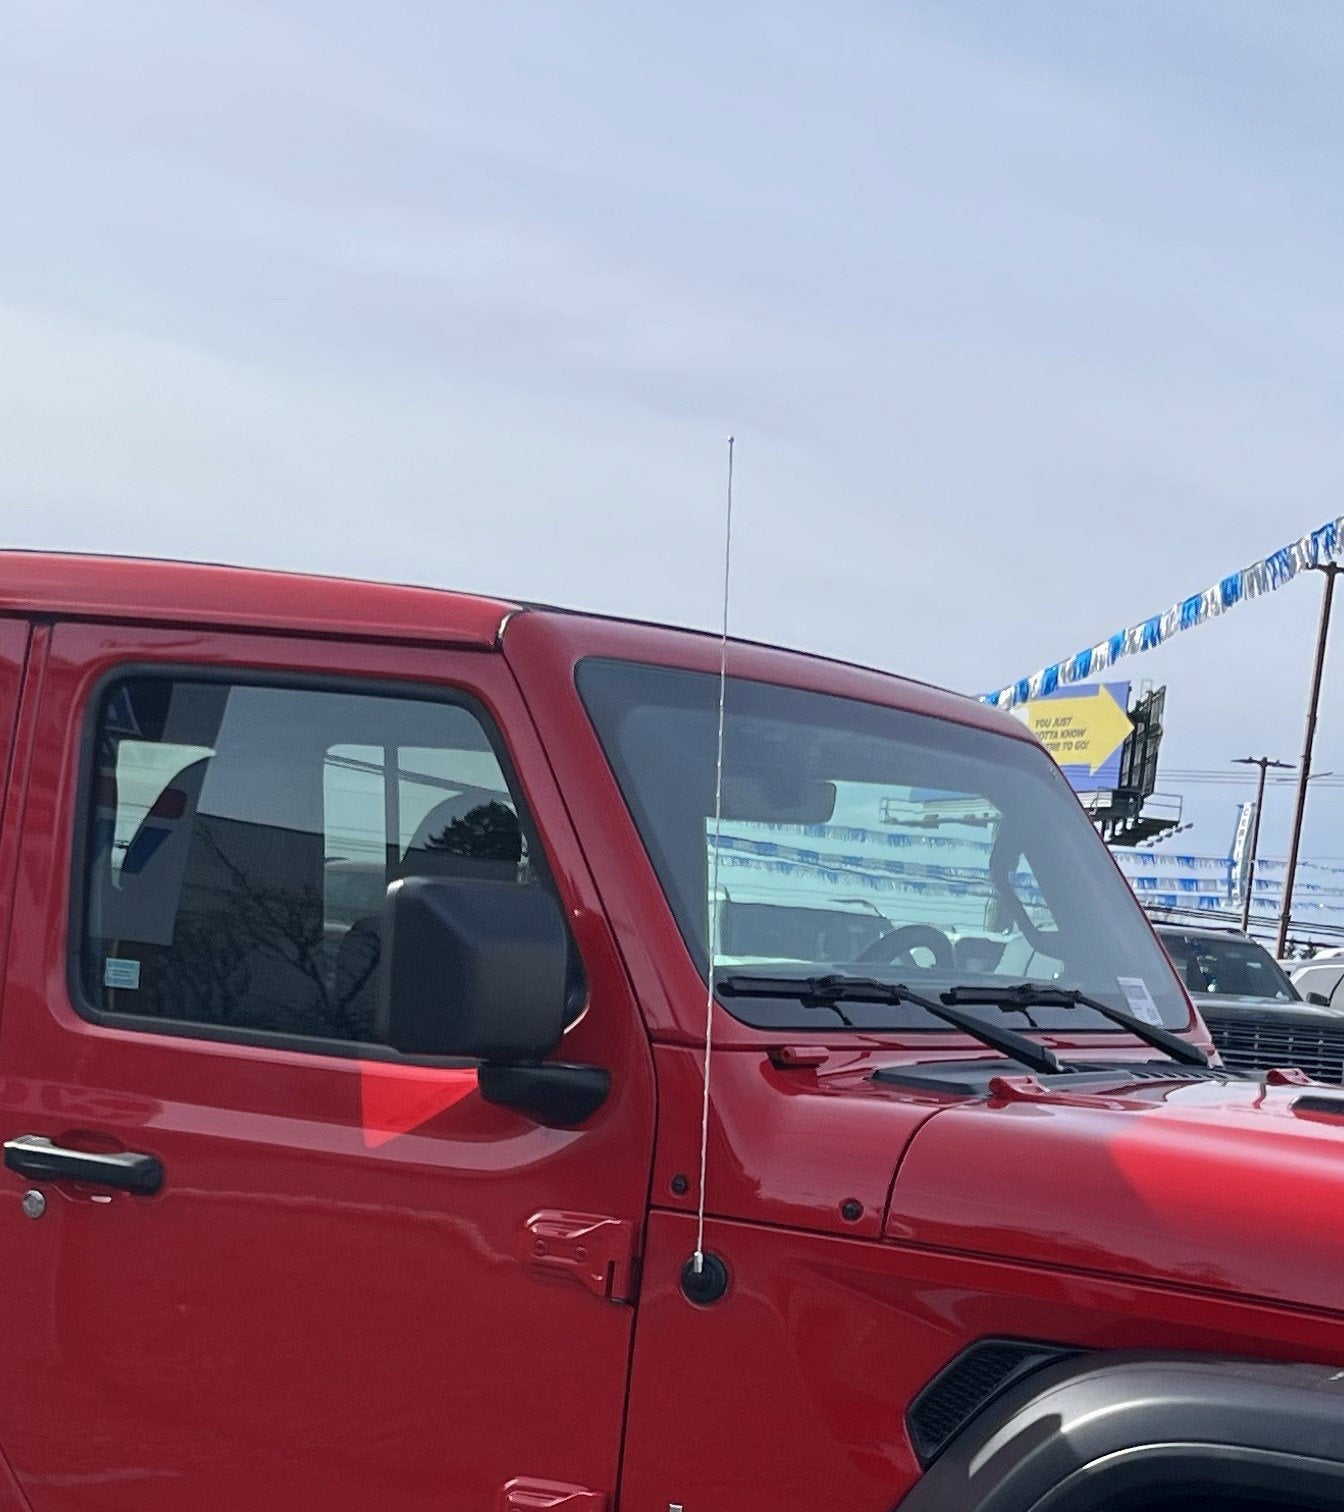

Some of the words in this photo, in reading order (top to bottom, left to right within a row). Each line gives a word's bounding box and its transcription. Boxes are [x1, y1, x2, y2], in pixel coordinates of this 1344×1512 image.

[1036, 718, 1052, 728] YOU
[1052, 716, 1073, 728] JUST
[1061, 727, 1087, 738] KNOW
[1062, 741, 1073, 751] TO
